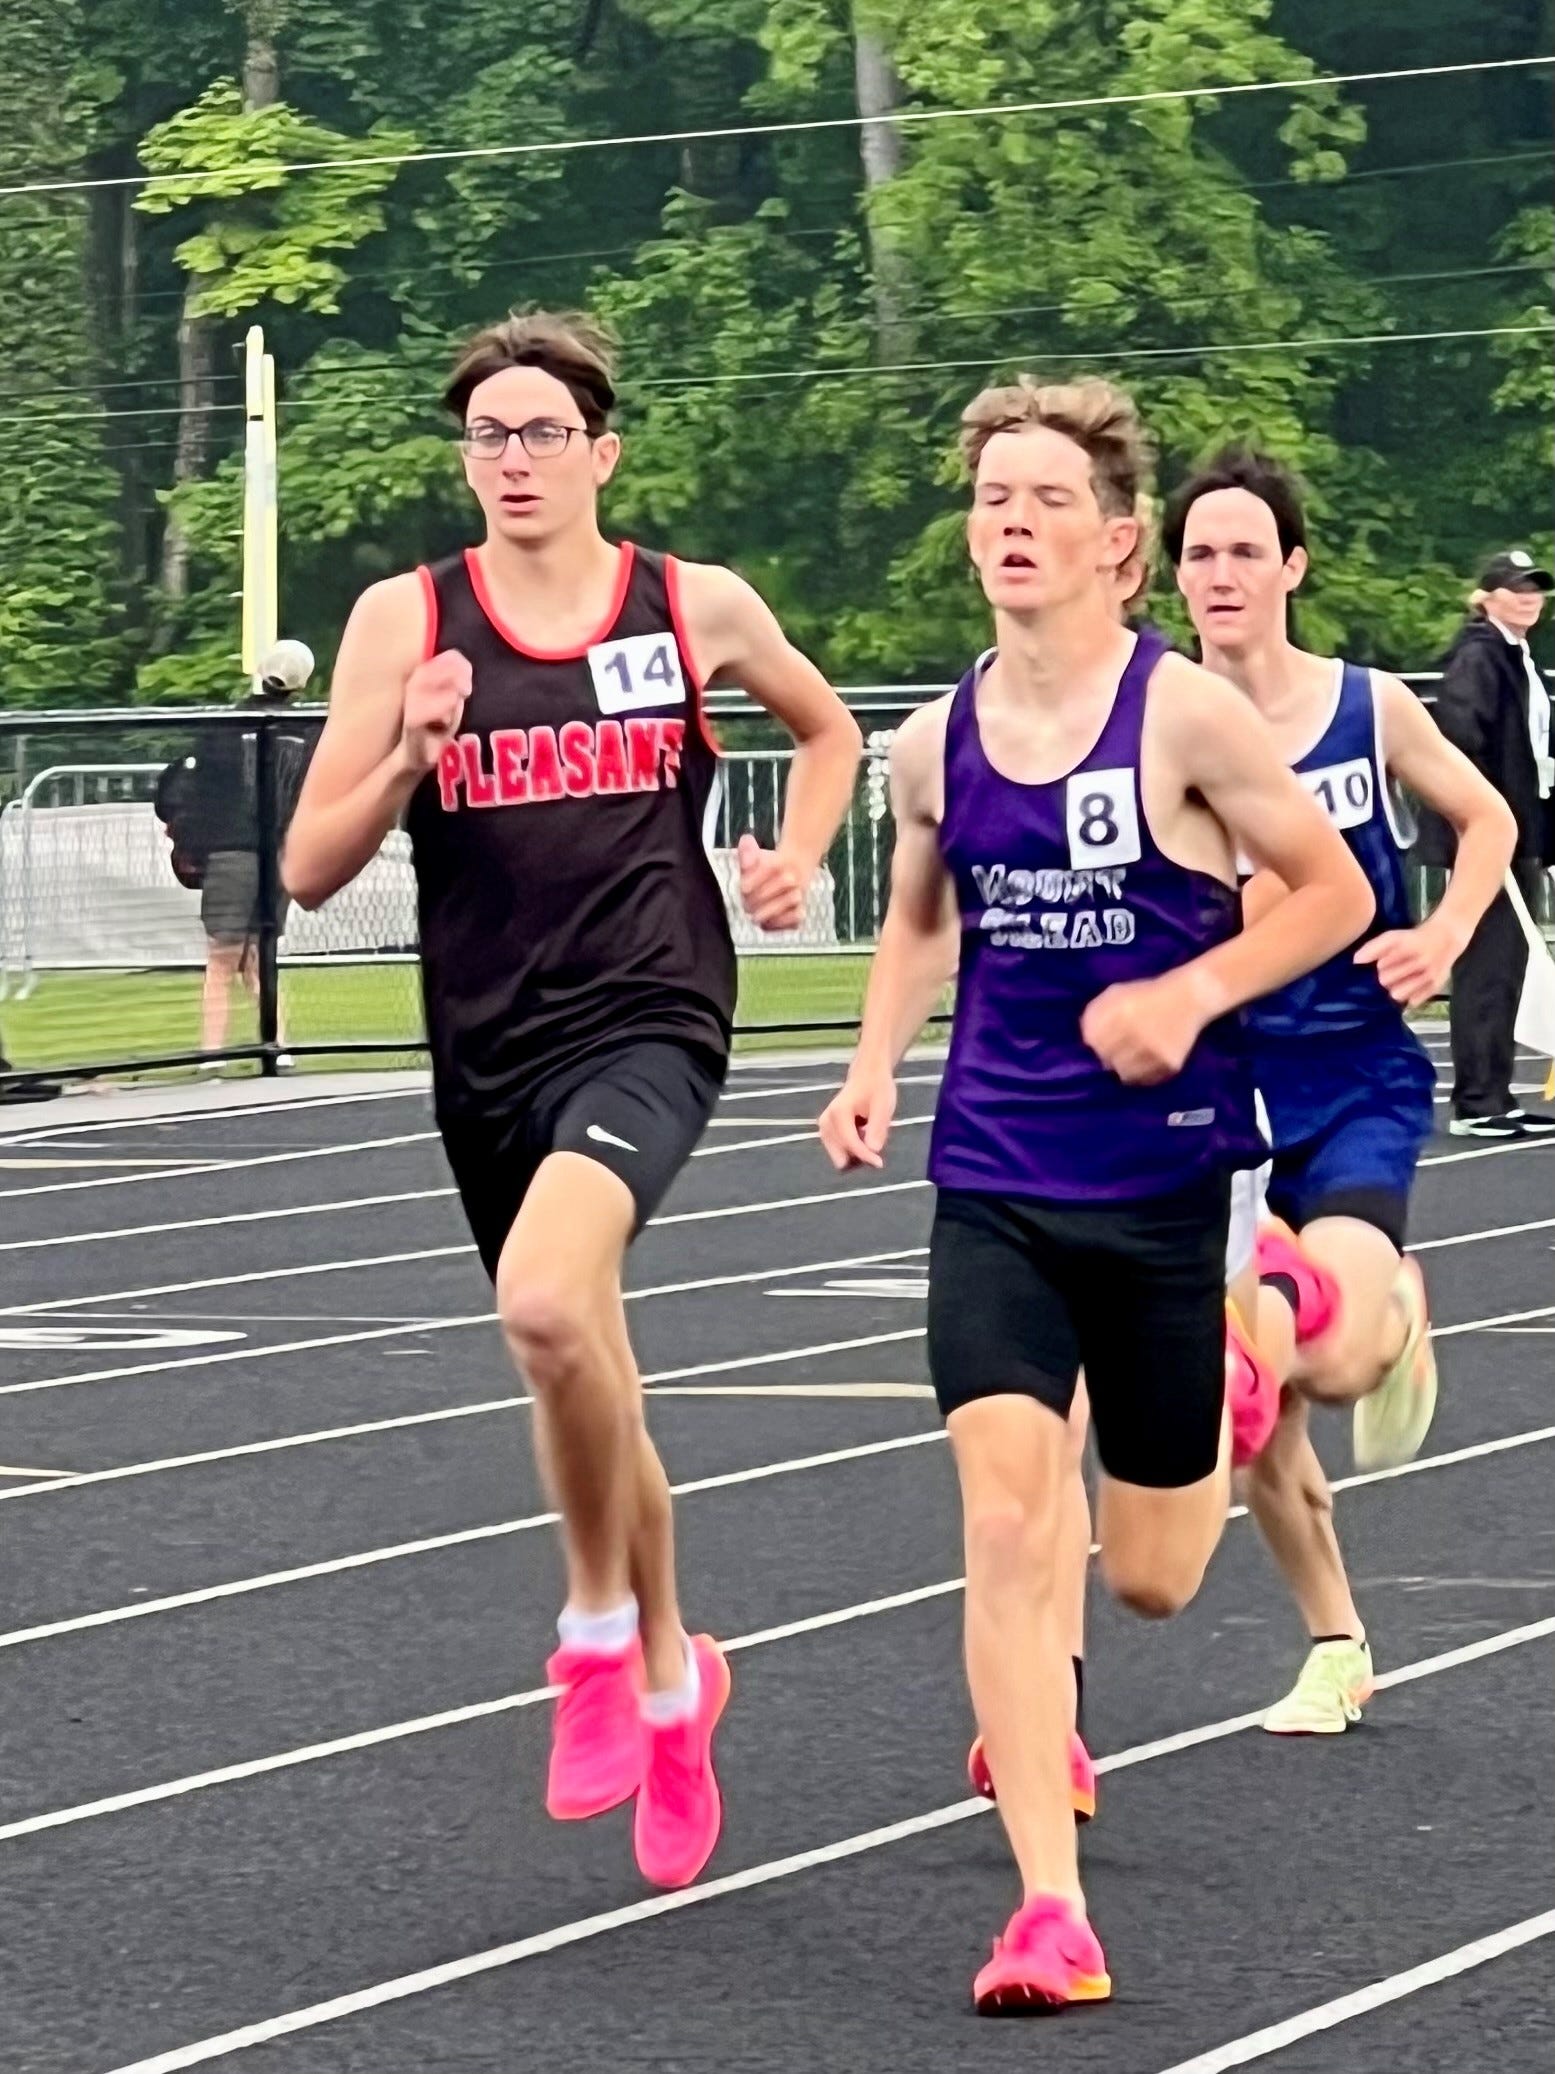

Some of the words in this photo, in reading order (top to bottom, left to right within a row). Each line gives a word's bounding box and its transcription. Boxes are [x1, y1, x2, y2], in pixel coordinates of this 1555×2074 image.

[604, 645, 676, 694] 14
[437, 718, 686, 813] PLEASANT
[1078, 791, 1120, 847] 8
[1313, 771, 1369, 816] 10
